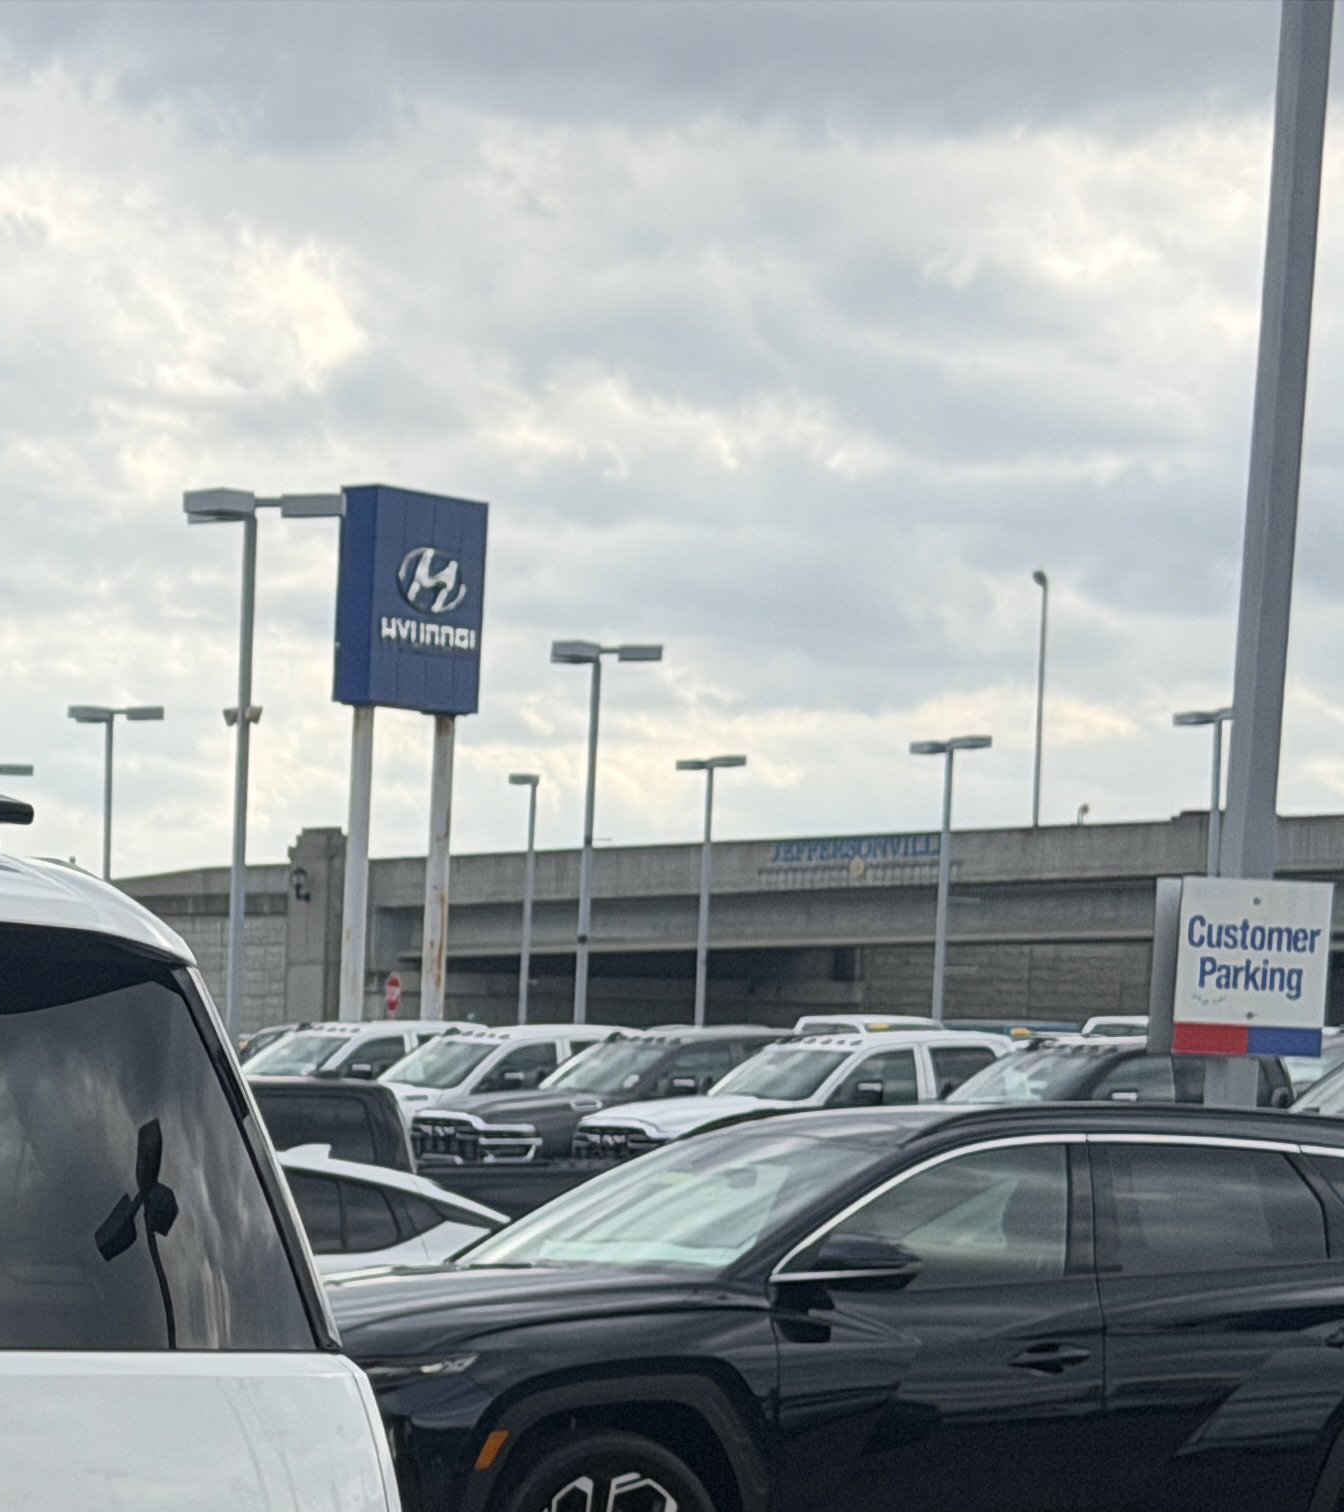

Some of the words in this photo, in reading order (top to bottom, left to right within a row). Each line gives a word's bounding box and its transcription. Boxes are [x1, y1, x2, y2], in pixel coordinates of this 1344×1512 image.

[381, 616, 475, 649] HYUNDAI
[772, 833, 942, 862] JEFFERSONVILL
[1188, 915, 1321, 954] Customer
[1199, 956, 1303, 1000] Parking
